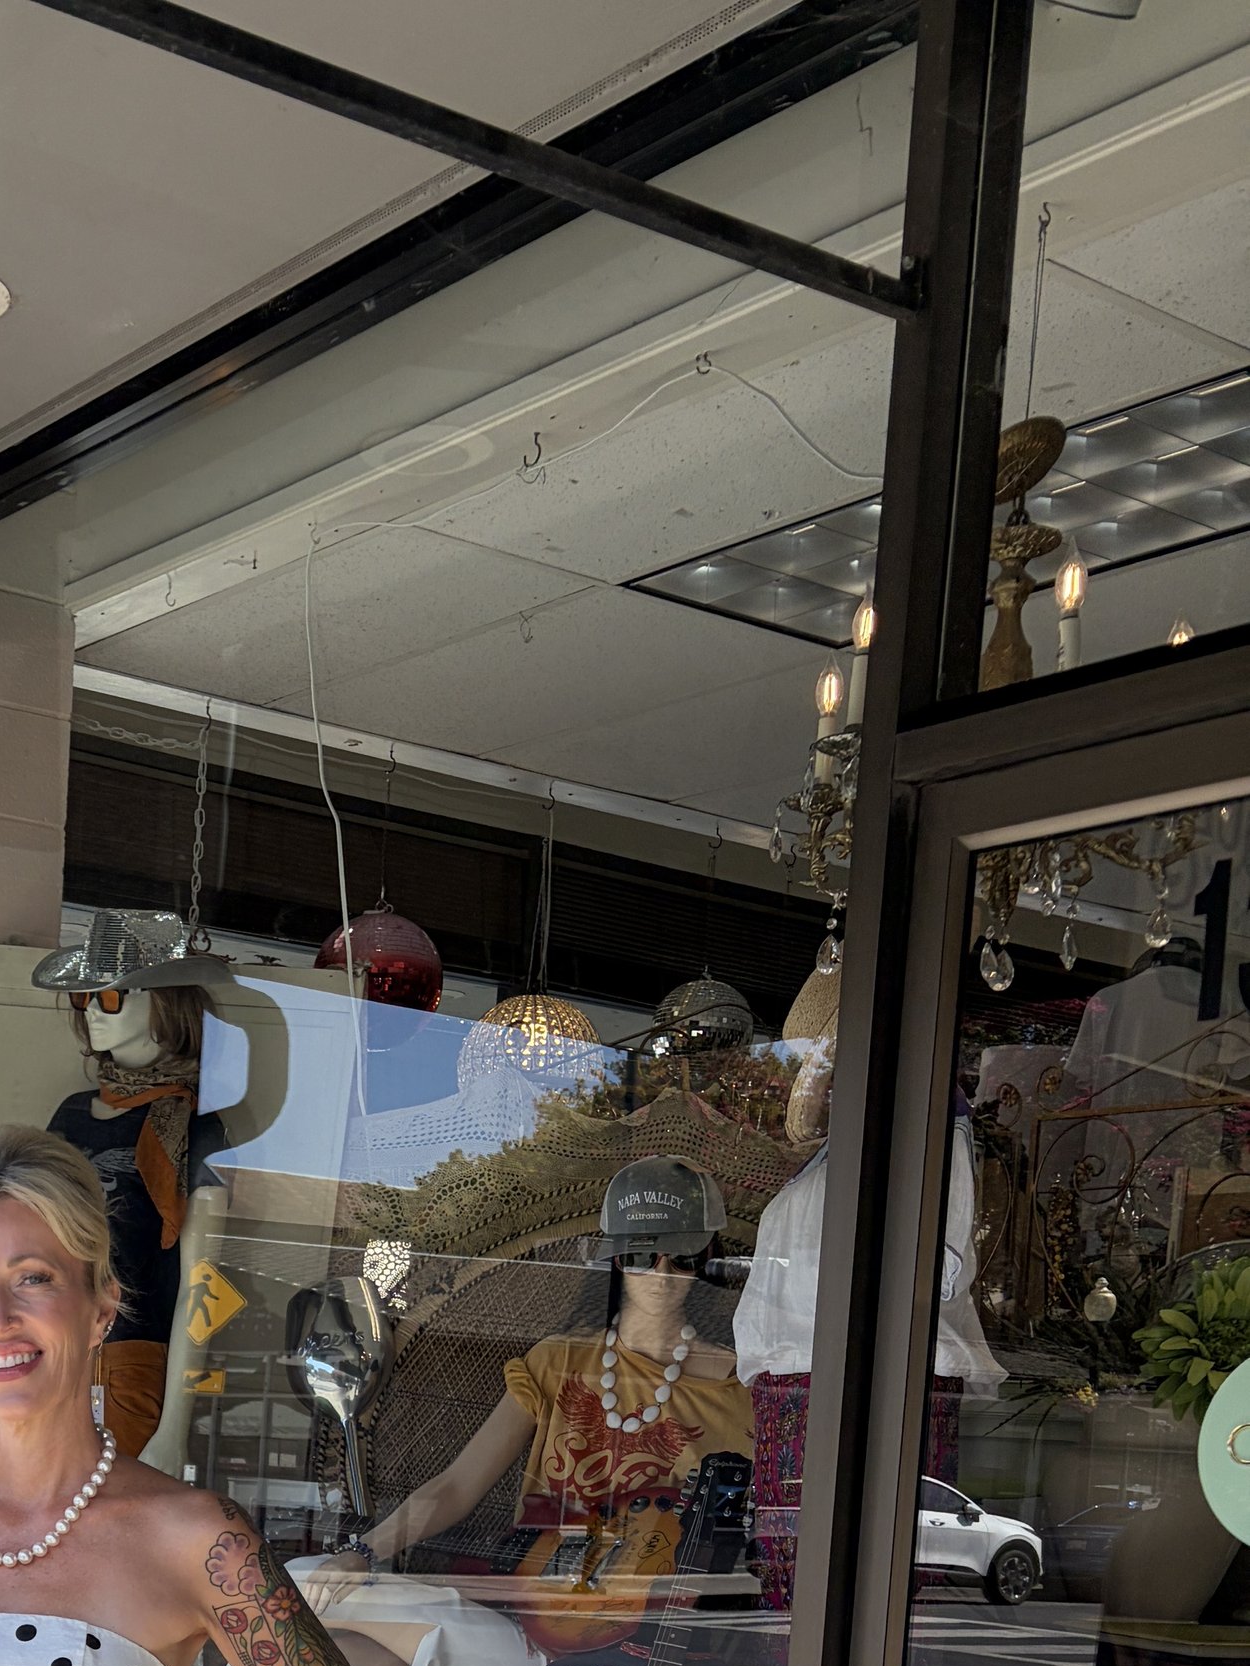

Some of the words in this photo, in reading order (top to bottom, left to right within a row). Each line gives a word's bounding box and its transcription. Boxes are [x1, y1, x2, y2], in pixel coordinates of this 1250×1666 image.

[617, 1192, 641, 1211] NAPA
[643, 1191, 684, 1210] VALLEY
[626, 1213, 669, 1221] CALIFORNIA
